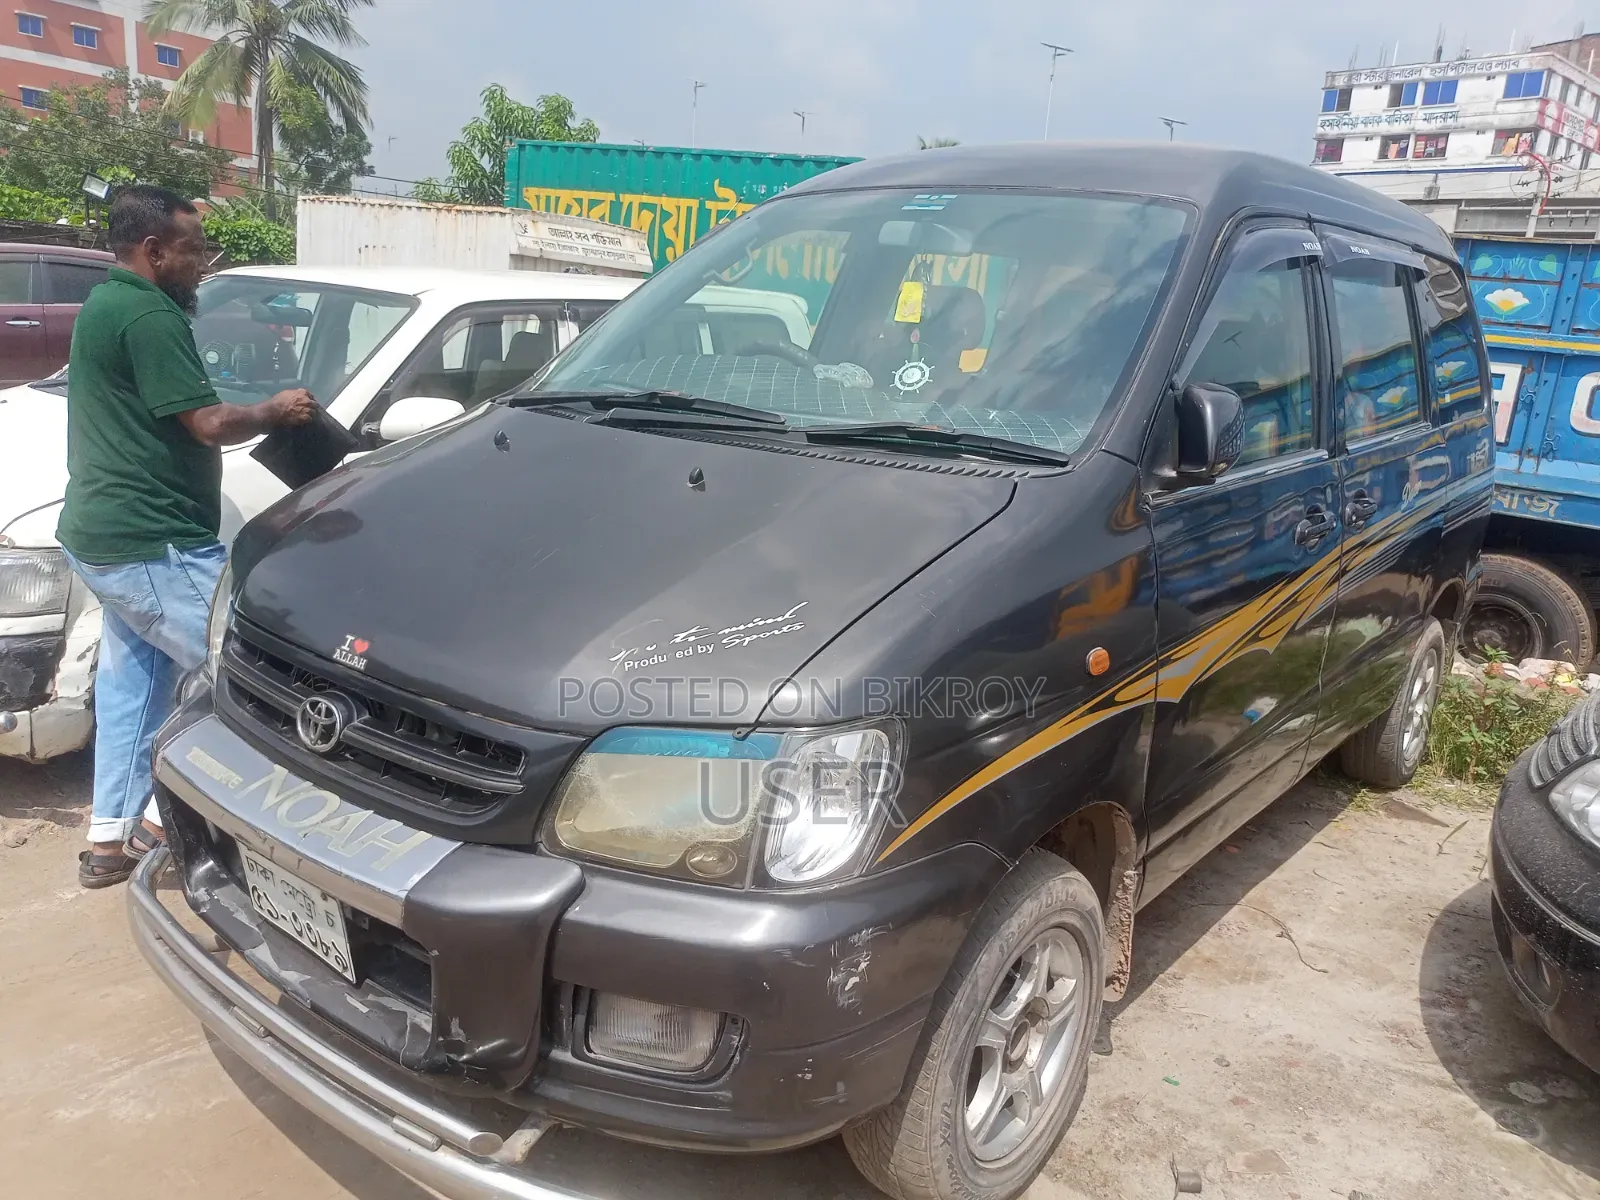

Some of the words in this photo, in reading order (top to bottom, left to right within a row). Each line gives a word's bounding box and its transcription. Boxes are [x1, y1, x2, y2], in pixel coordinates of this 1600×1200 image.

[341, 634, 356, 651] I
[697, 642, 715, 661] by
[720, 621, 805, 650] Sports
[332, 648, 368, 670] ALLAH
[234, 763, 433, 872] NOAH
[245, 855, 276, 888] ঢাকা
